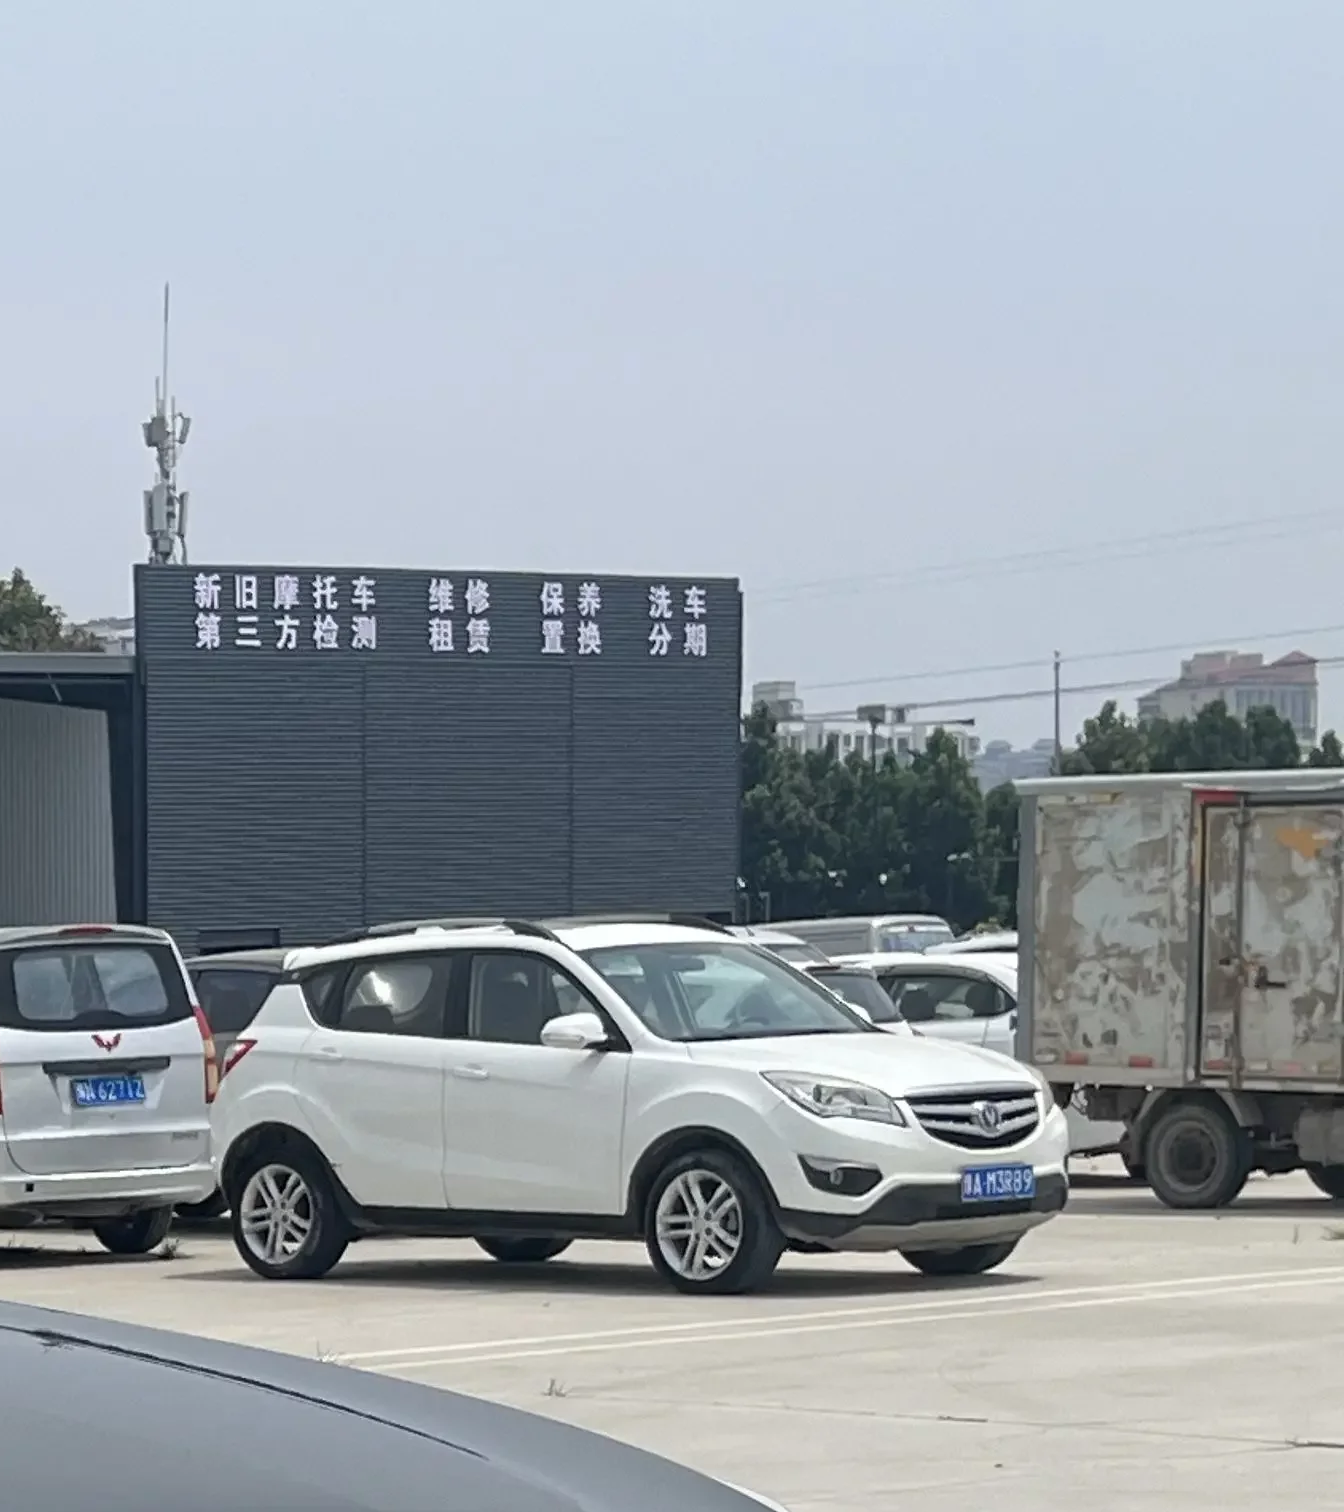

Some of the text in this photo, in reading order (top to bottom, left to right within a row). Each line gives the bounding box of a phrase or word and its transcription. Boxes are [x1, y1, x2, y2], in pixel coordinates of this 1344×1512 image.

[194, 573, 708, 620] 新旧摩托车 维修 保养 洗车
[194, 613, 708, 657] 第三方检测 租赁 置换 分期
